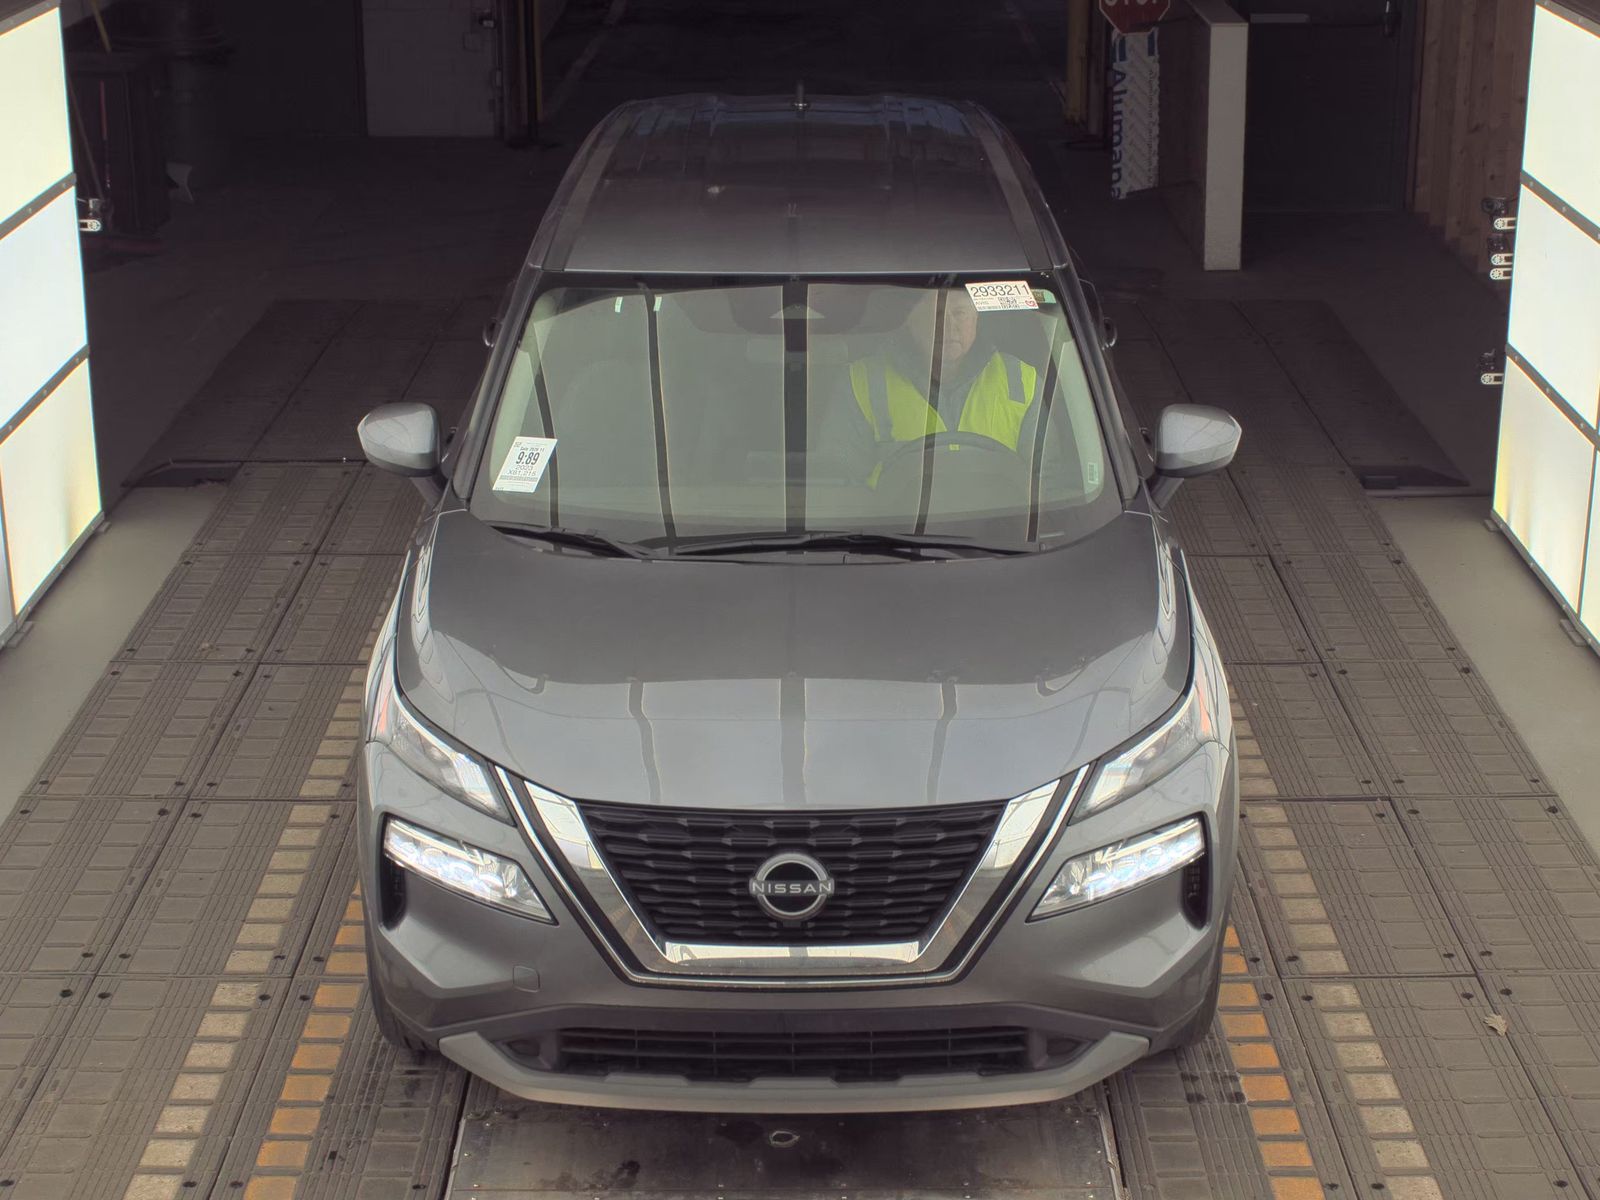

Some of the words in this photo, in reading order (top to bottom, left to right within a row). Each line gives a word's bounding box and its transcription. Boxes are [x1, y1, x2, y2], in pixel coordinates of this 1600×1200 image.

[970, 284, 1030, 297] 2933211
[516, 451, 540, 465] 9:89
[752, 882, 832, 894] NISSAN
